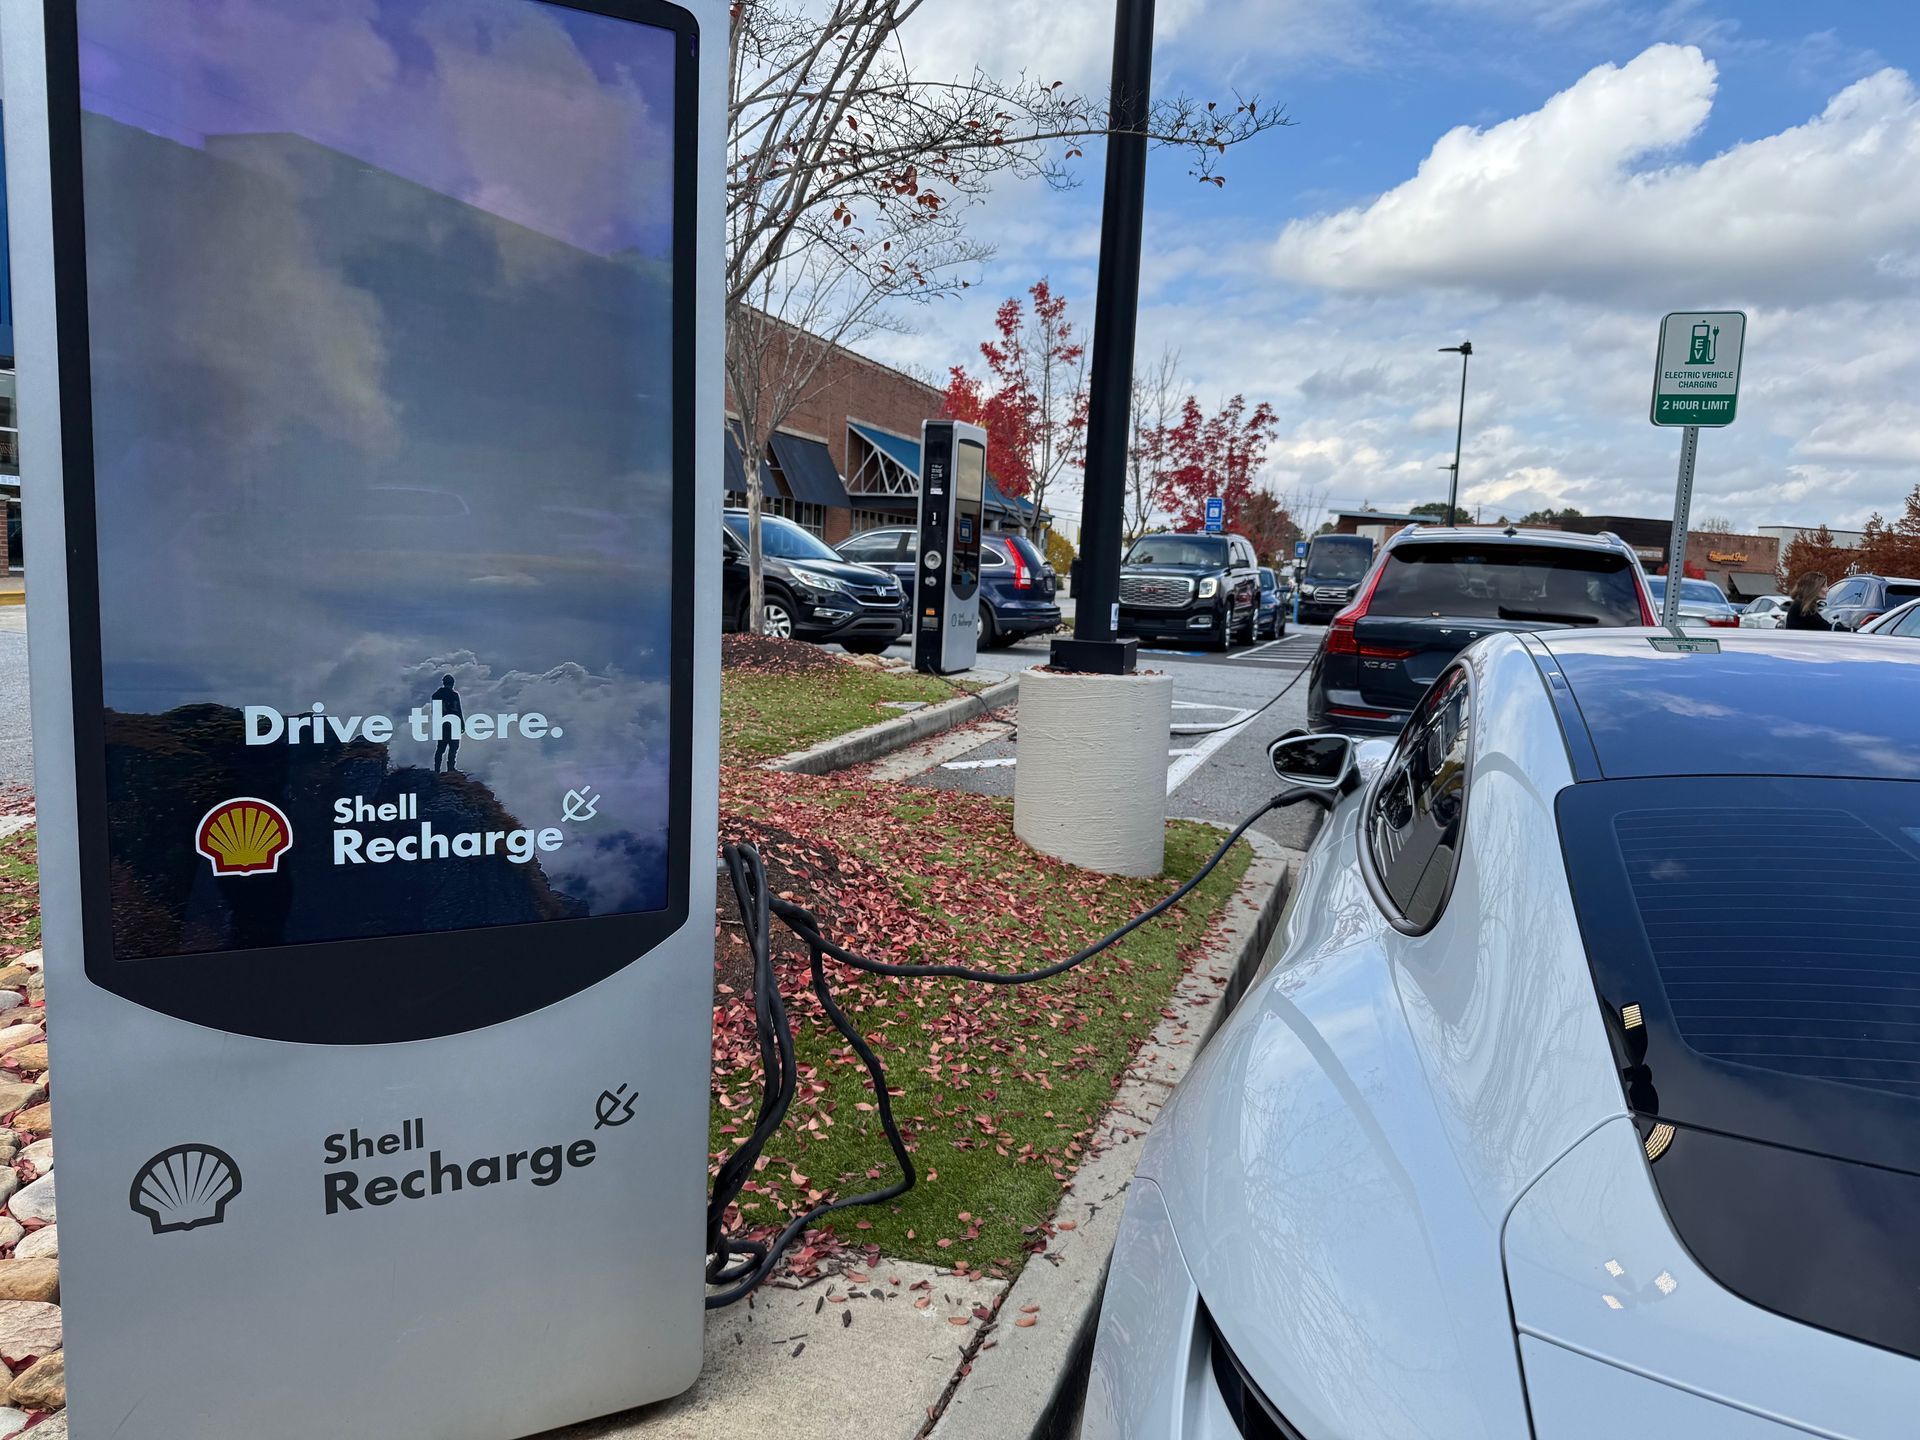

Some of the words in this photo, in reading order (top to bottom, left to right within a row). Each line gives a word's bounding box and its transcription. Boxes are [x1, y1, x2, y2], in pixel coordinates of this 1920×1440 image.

[1664, 371, 1700, 379] ELECTRIC
[1702, 371, 1733, 379] VEHICLE
[1678, 380, 1718, 389] CHARGING
[1662, 400, 1670, 410] 2
[1672, 400, 1699, 410] HOUR
[1702, 400, 1730, 410] LIMIT
[245, 702, 394, 746] Drive
[409, 699, 564, 741] there.
[333, 793, 418, 824] Shell
[333, 821, 565, 866] Recharge
[323, 1117, 424, 1165] Shell
[323, 1138, 597, 1216] Recharge
